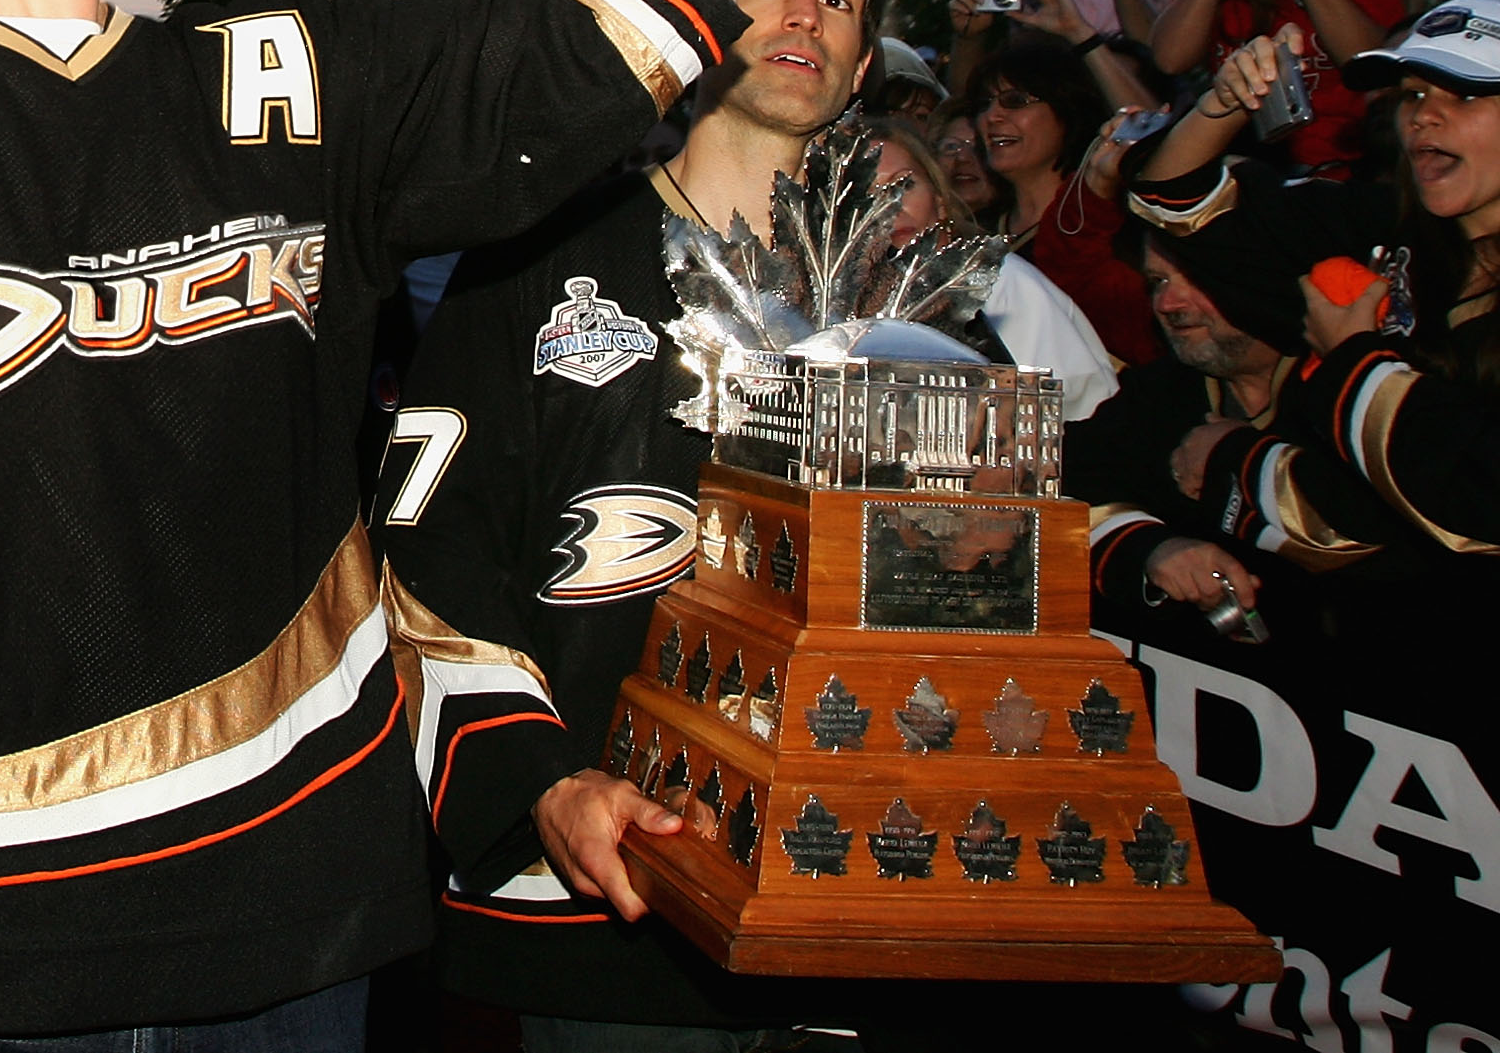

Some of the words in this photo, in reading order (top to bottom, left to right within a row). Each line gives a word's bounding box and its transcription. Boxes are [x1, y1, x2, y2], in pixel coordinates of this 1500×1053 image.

[212, 10, 322, 145] A
[67, 213, 289, 270] ANAHEIM
[538, 331, 613, 367] STANLEY
[613, 331, 655, 353] CUP
[579, 353, 606, 364] 2007
[376, 406, 468, 526] 7
[1120, 636, 1500, 914] DA
